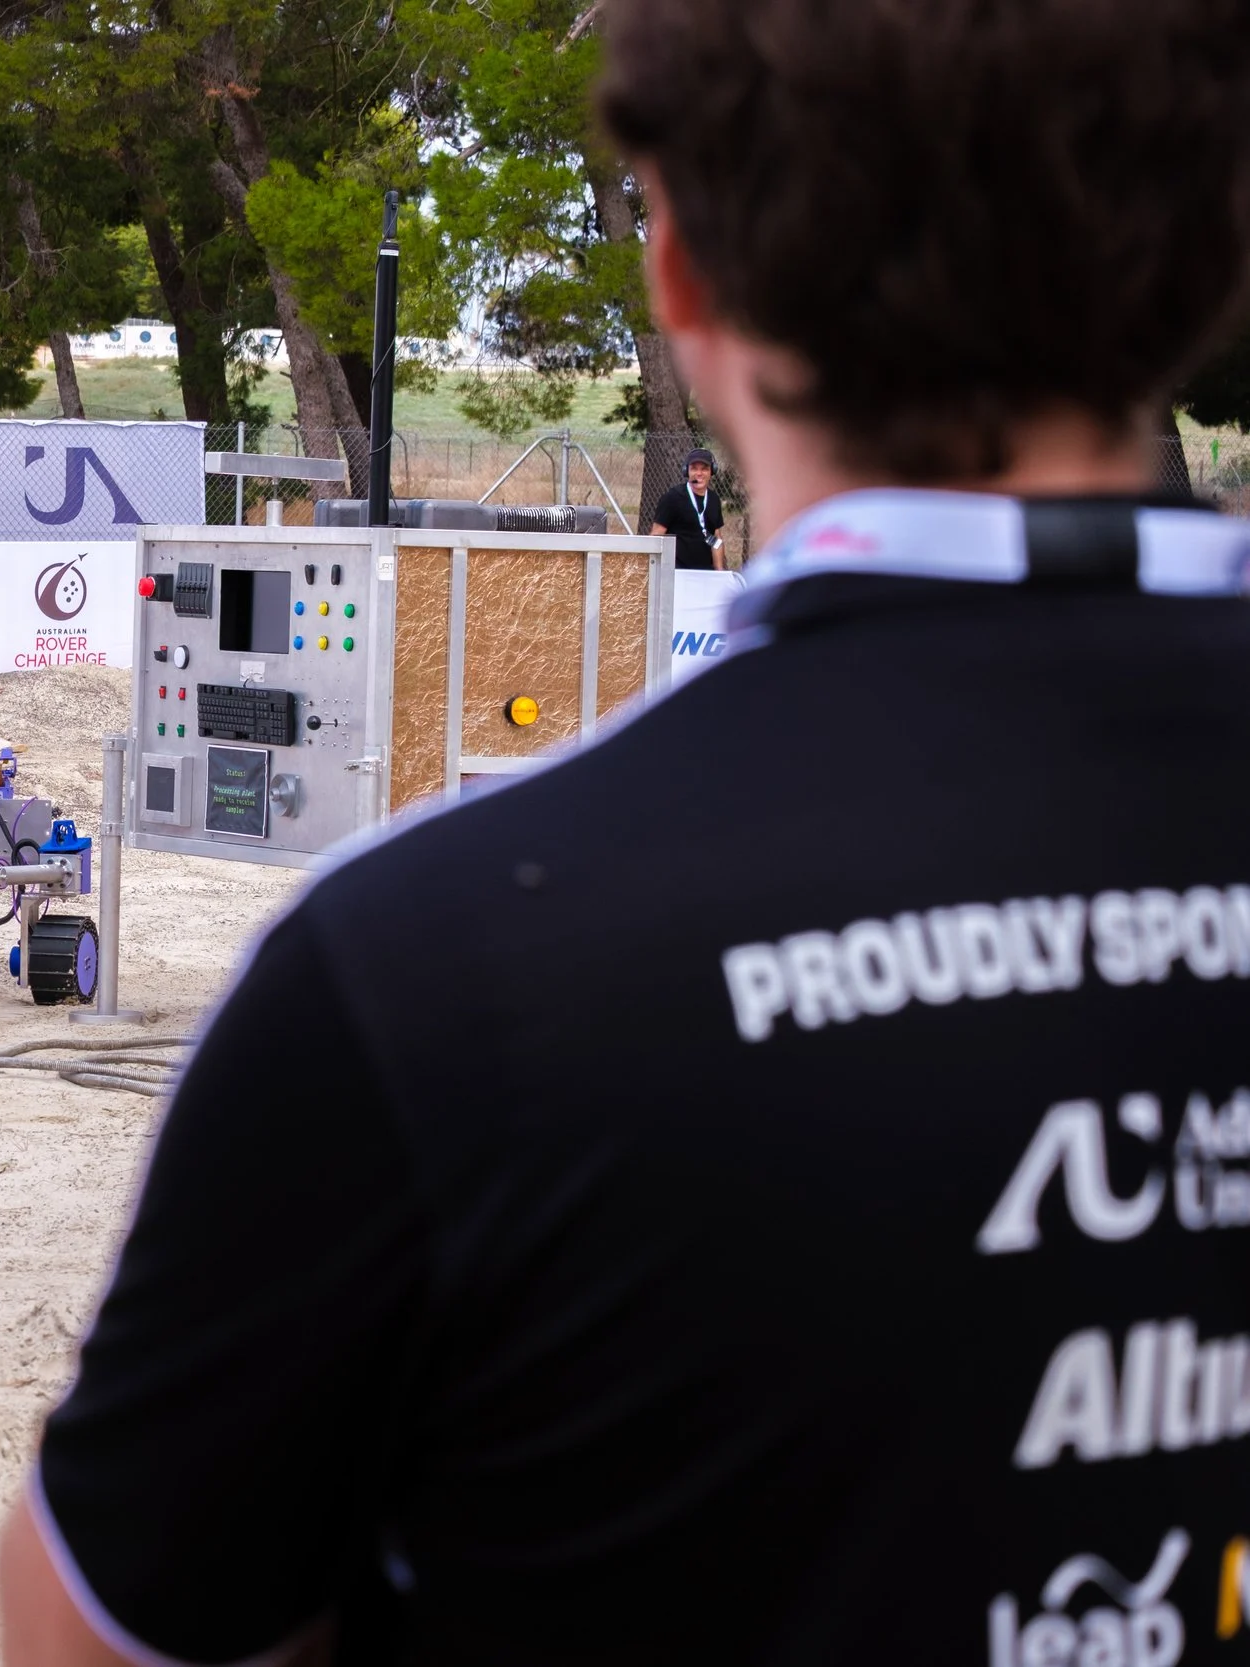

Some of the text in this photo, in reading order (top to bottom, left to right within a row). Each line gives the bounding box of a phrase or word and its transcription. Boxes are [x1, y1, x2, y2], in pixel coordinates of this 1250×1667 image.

[36, 637, 87, 651] ROVER
[671, 631, 727, 656] ING
[225, 768, 246, 777] Status:
[213, 785, 240, 796] Processing
[213, 796, 227, 804] ready
[225, 806, 245, 814] samples
[723, 894, 1087, 1042] PROUDLY
